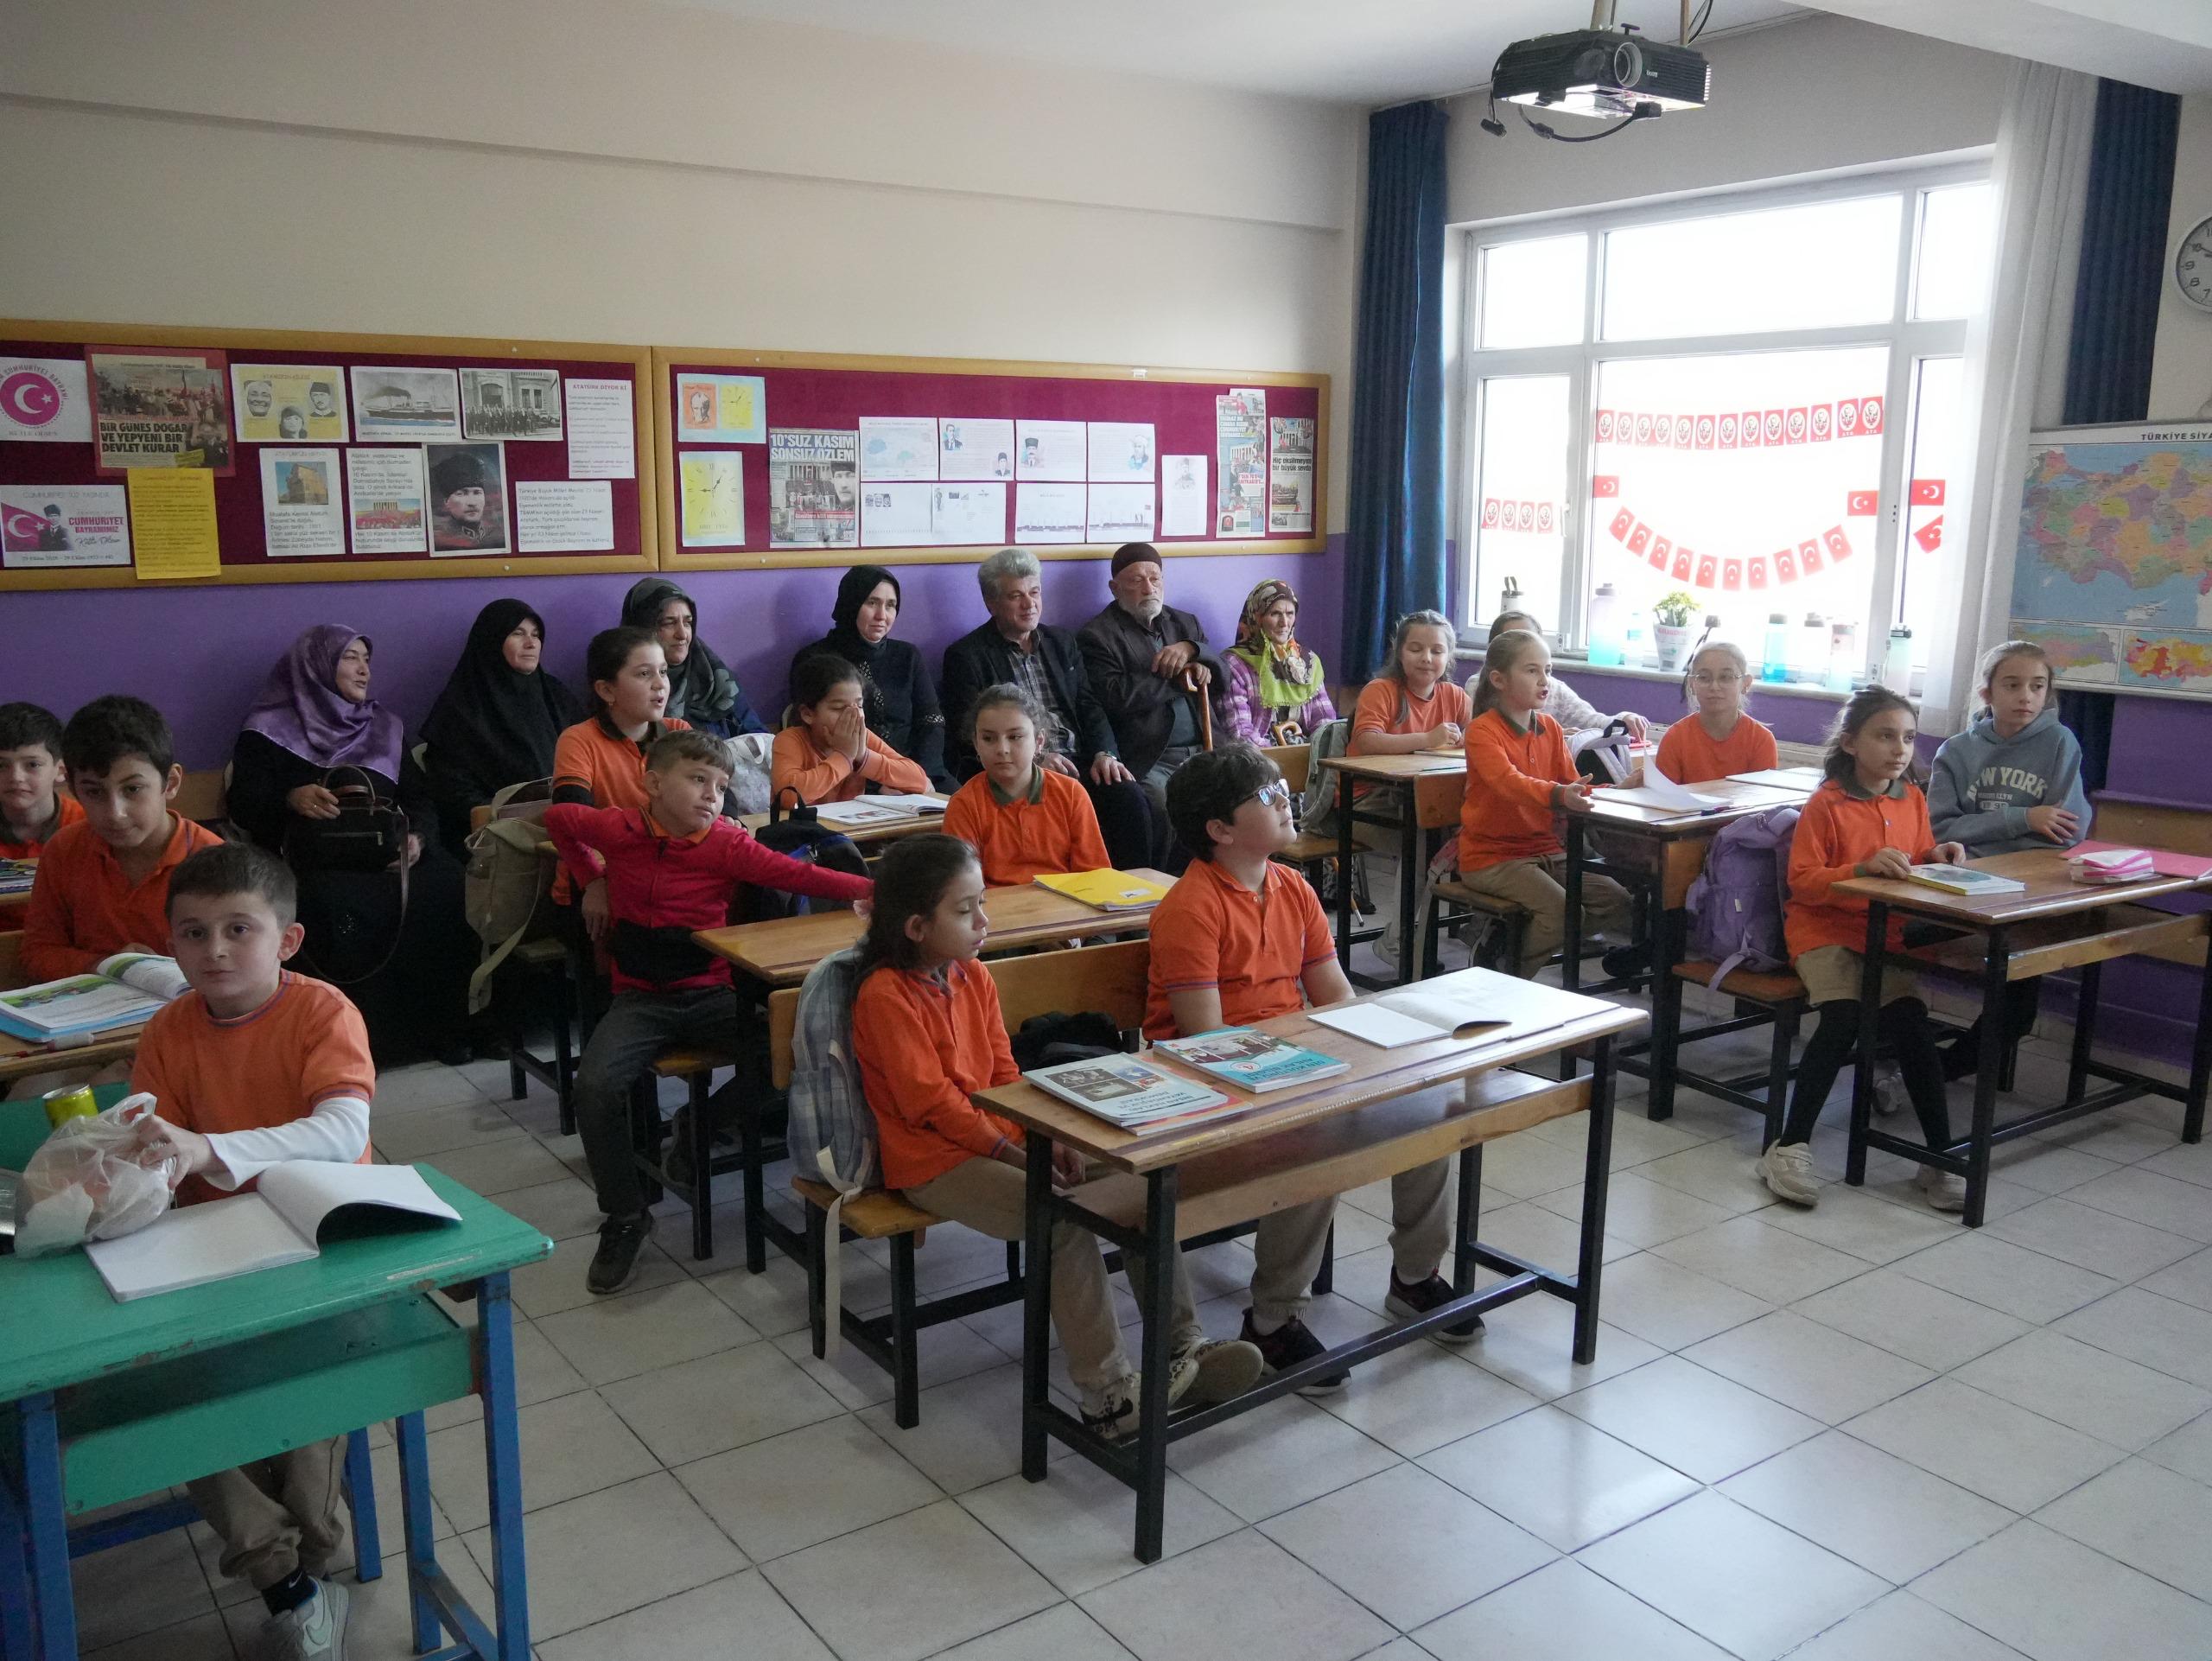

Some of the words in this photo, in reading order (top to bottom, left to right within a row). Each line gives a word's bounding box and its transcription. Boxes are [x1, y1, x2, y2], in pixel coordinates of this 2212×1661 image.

[2184, 261, 2195, 270] 9
[2190, 277, 2200, 286] 8
[2202, 288, 2210, 298] 7
[100, 423, 118, 432] BİR
[102, 433, 115, 442] VE
[118, 433, 162, 442] YEPYENİ
[165, 434, 183, 442] BİR
[771, 434, 812, 447] 10'SUZ
[815, 436, 854, 448] KASIM
[2140, 431, 2188, 441] TÜRKİYE
[102, 443, 140, 452] DEVLET
[143, 444, 180, 453] KURAR
[771, 449, 814, 461] SONSUZ
[817, 449, 854, 461] ÖZLEM
[69, 517, 124, 525] CUMHURİYET
[2000, 767, 2048, 799] YORK
